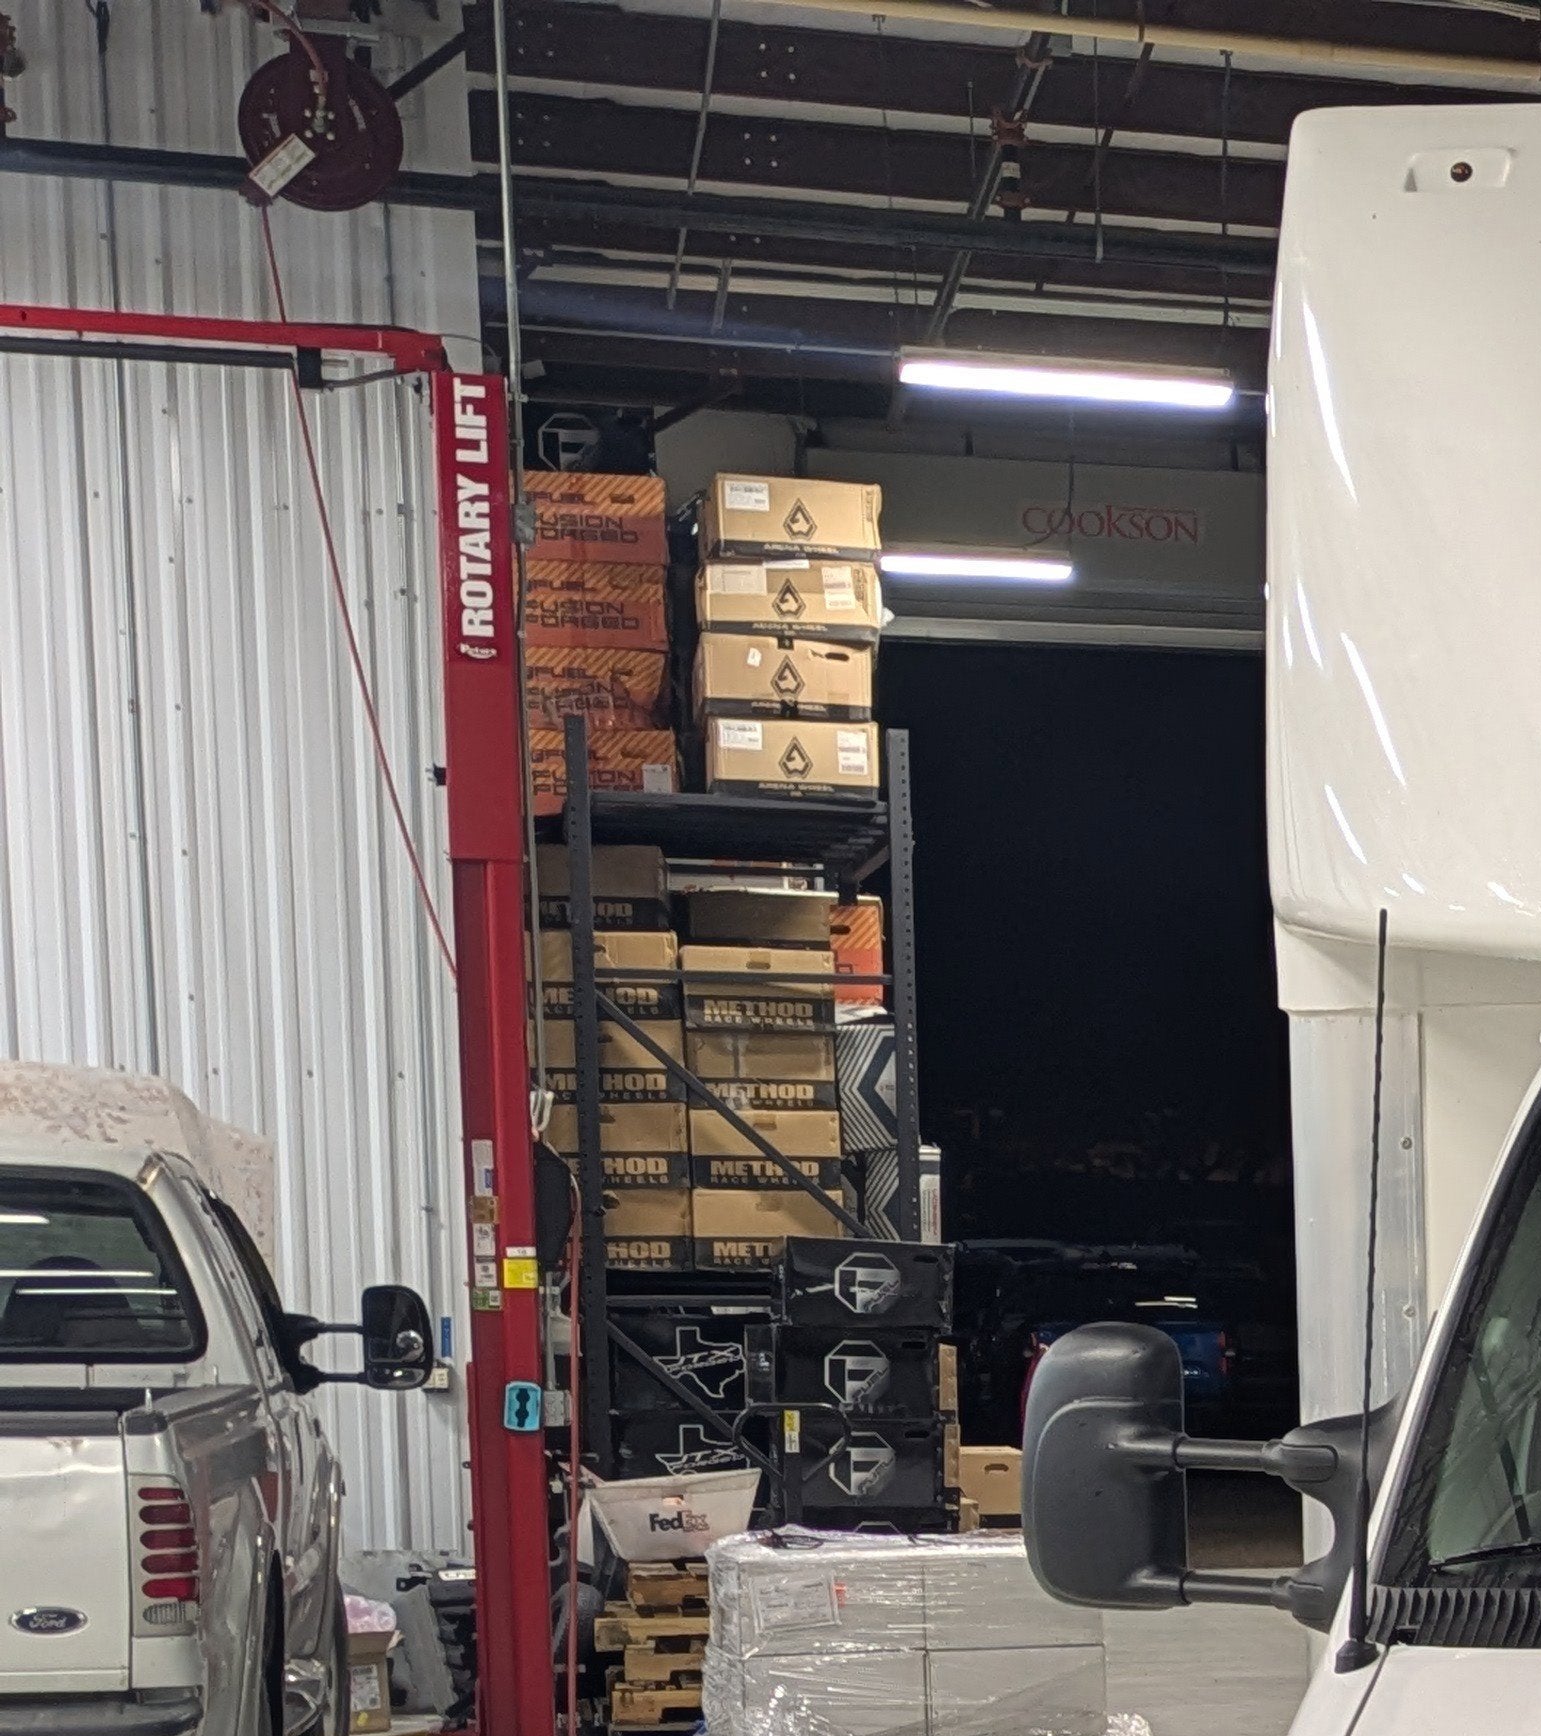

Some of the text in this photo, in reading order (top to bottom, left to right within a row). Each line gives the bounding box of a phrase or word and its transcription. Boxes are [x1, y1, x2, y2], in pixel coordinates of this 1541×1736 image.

[453, 377, 489, 464] LIFT
[540, 513, 625, 529] USION
[540, 529, 639, 544] ORGED
[457, 474, 495, 638] ROTARY
[704, 1000, 814, 1017] METHOD
[710, 1160, 820, 1177] METHD
[649, 1510, 711, 1533] FedEx
